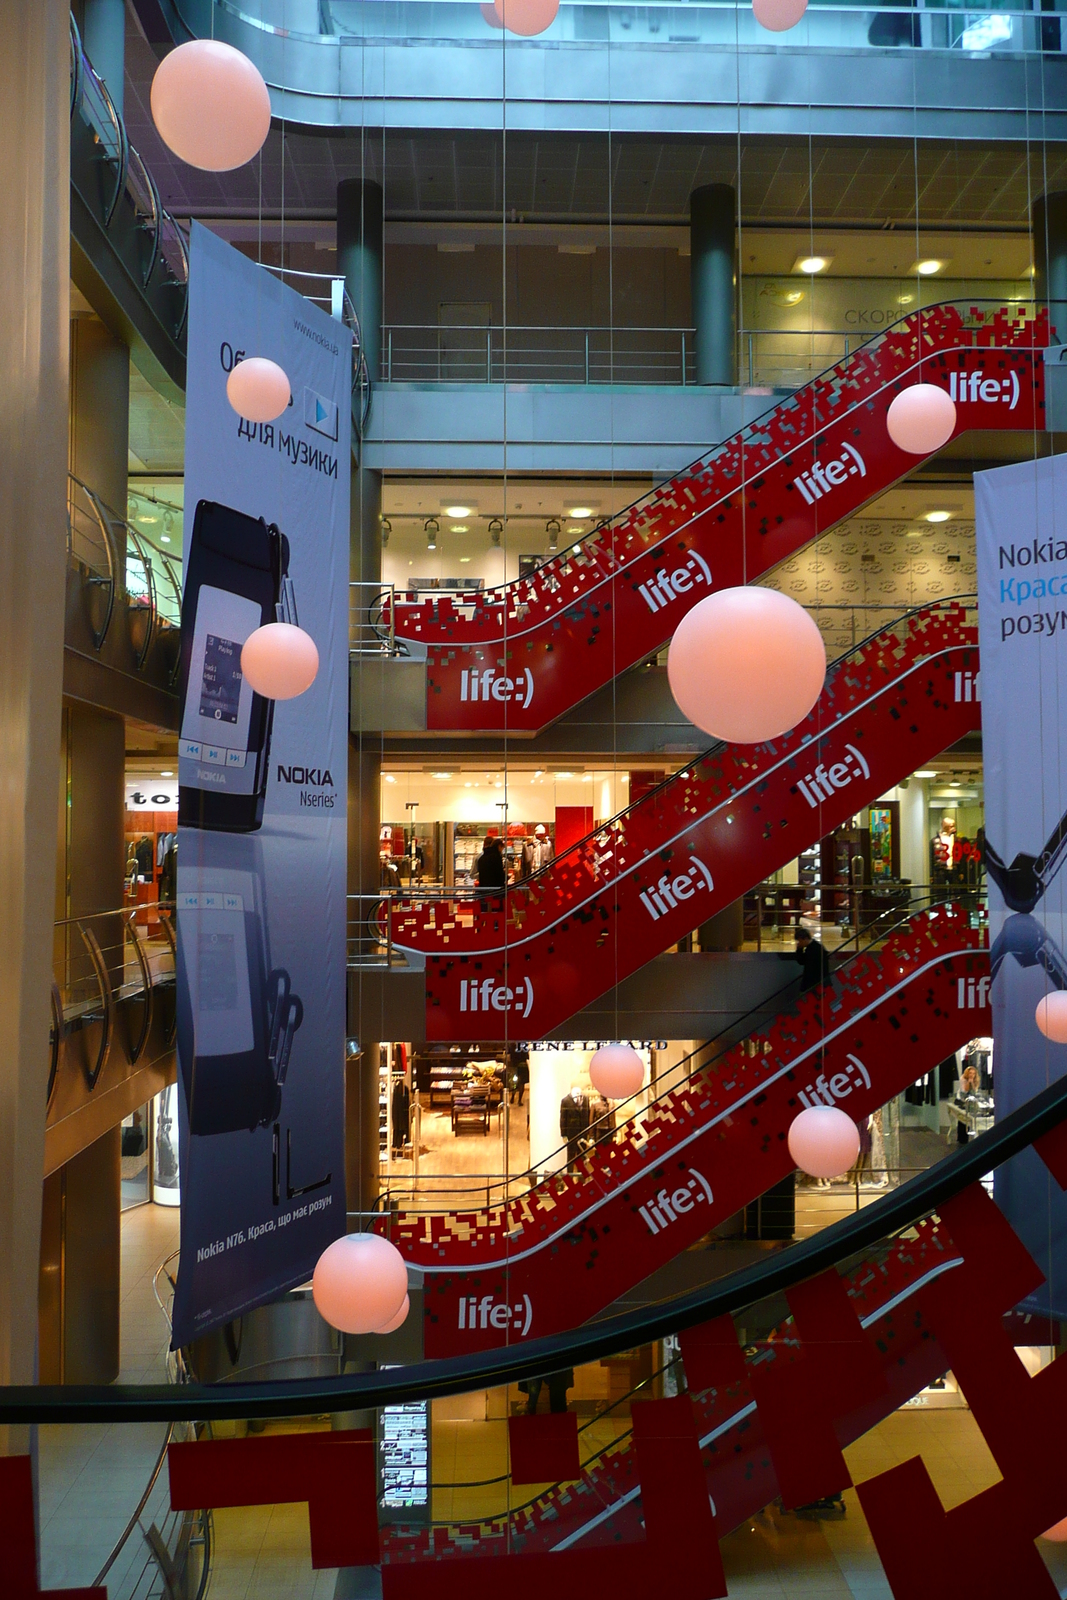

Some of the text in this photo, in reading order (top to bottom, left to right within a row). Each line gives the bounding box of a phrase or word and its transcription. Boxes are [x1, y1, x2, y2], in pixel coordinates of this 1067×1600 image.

[220, 341, 246, 373] Об
[950, 370, 1020, 410] life:)
[278, 430, 339, 480] музики
[793, 441, 868, 505] life:)
[999, 537, 1067, 570] Nokia
[637, 549, 713, 614] life:)
[460, 667, 534, 710] life:)
[954, 671, 982, 702] lif
[196, 769, 227, 784] NOKIA
[277, 764, 334, 787] NOKIA
[796, 743, 871, 809] life:)
[129, 791, 179, 805] to
[638, 855, 715, 921] life:)
[459, 976, 534, 1018] life:)
[957, 975, 993, 1010] lif
[515, 1040, 669, 1053] RENE LEARD
[637, 1167, 715, 1236] life:)
[196, 1194, 333, 1264] Nokia N76. Краса, що має розум
[458, 1293, 534, 1338] life:)
